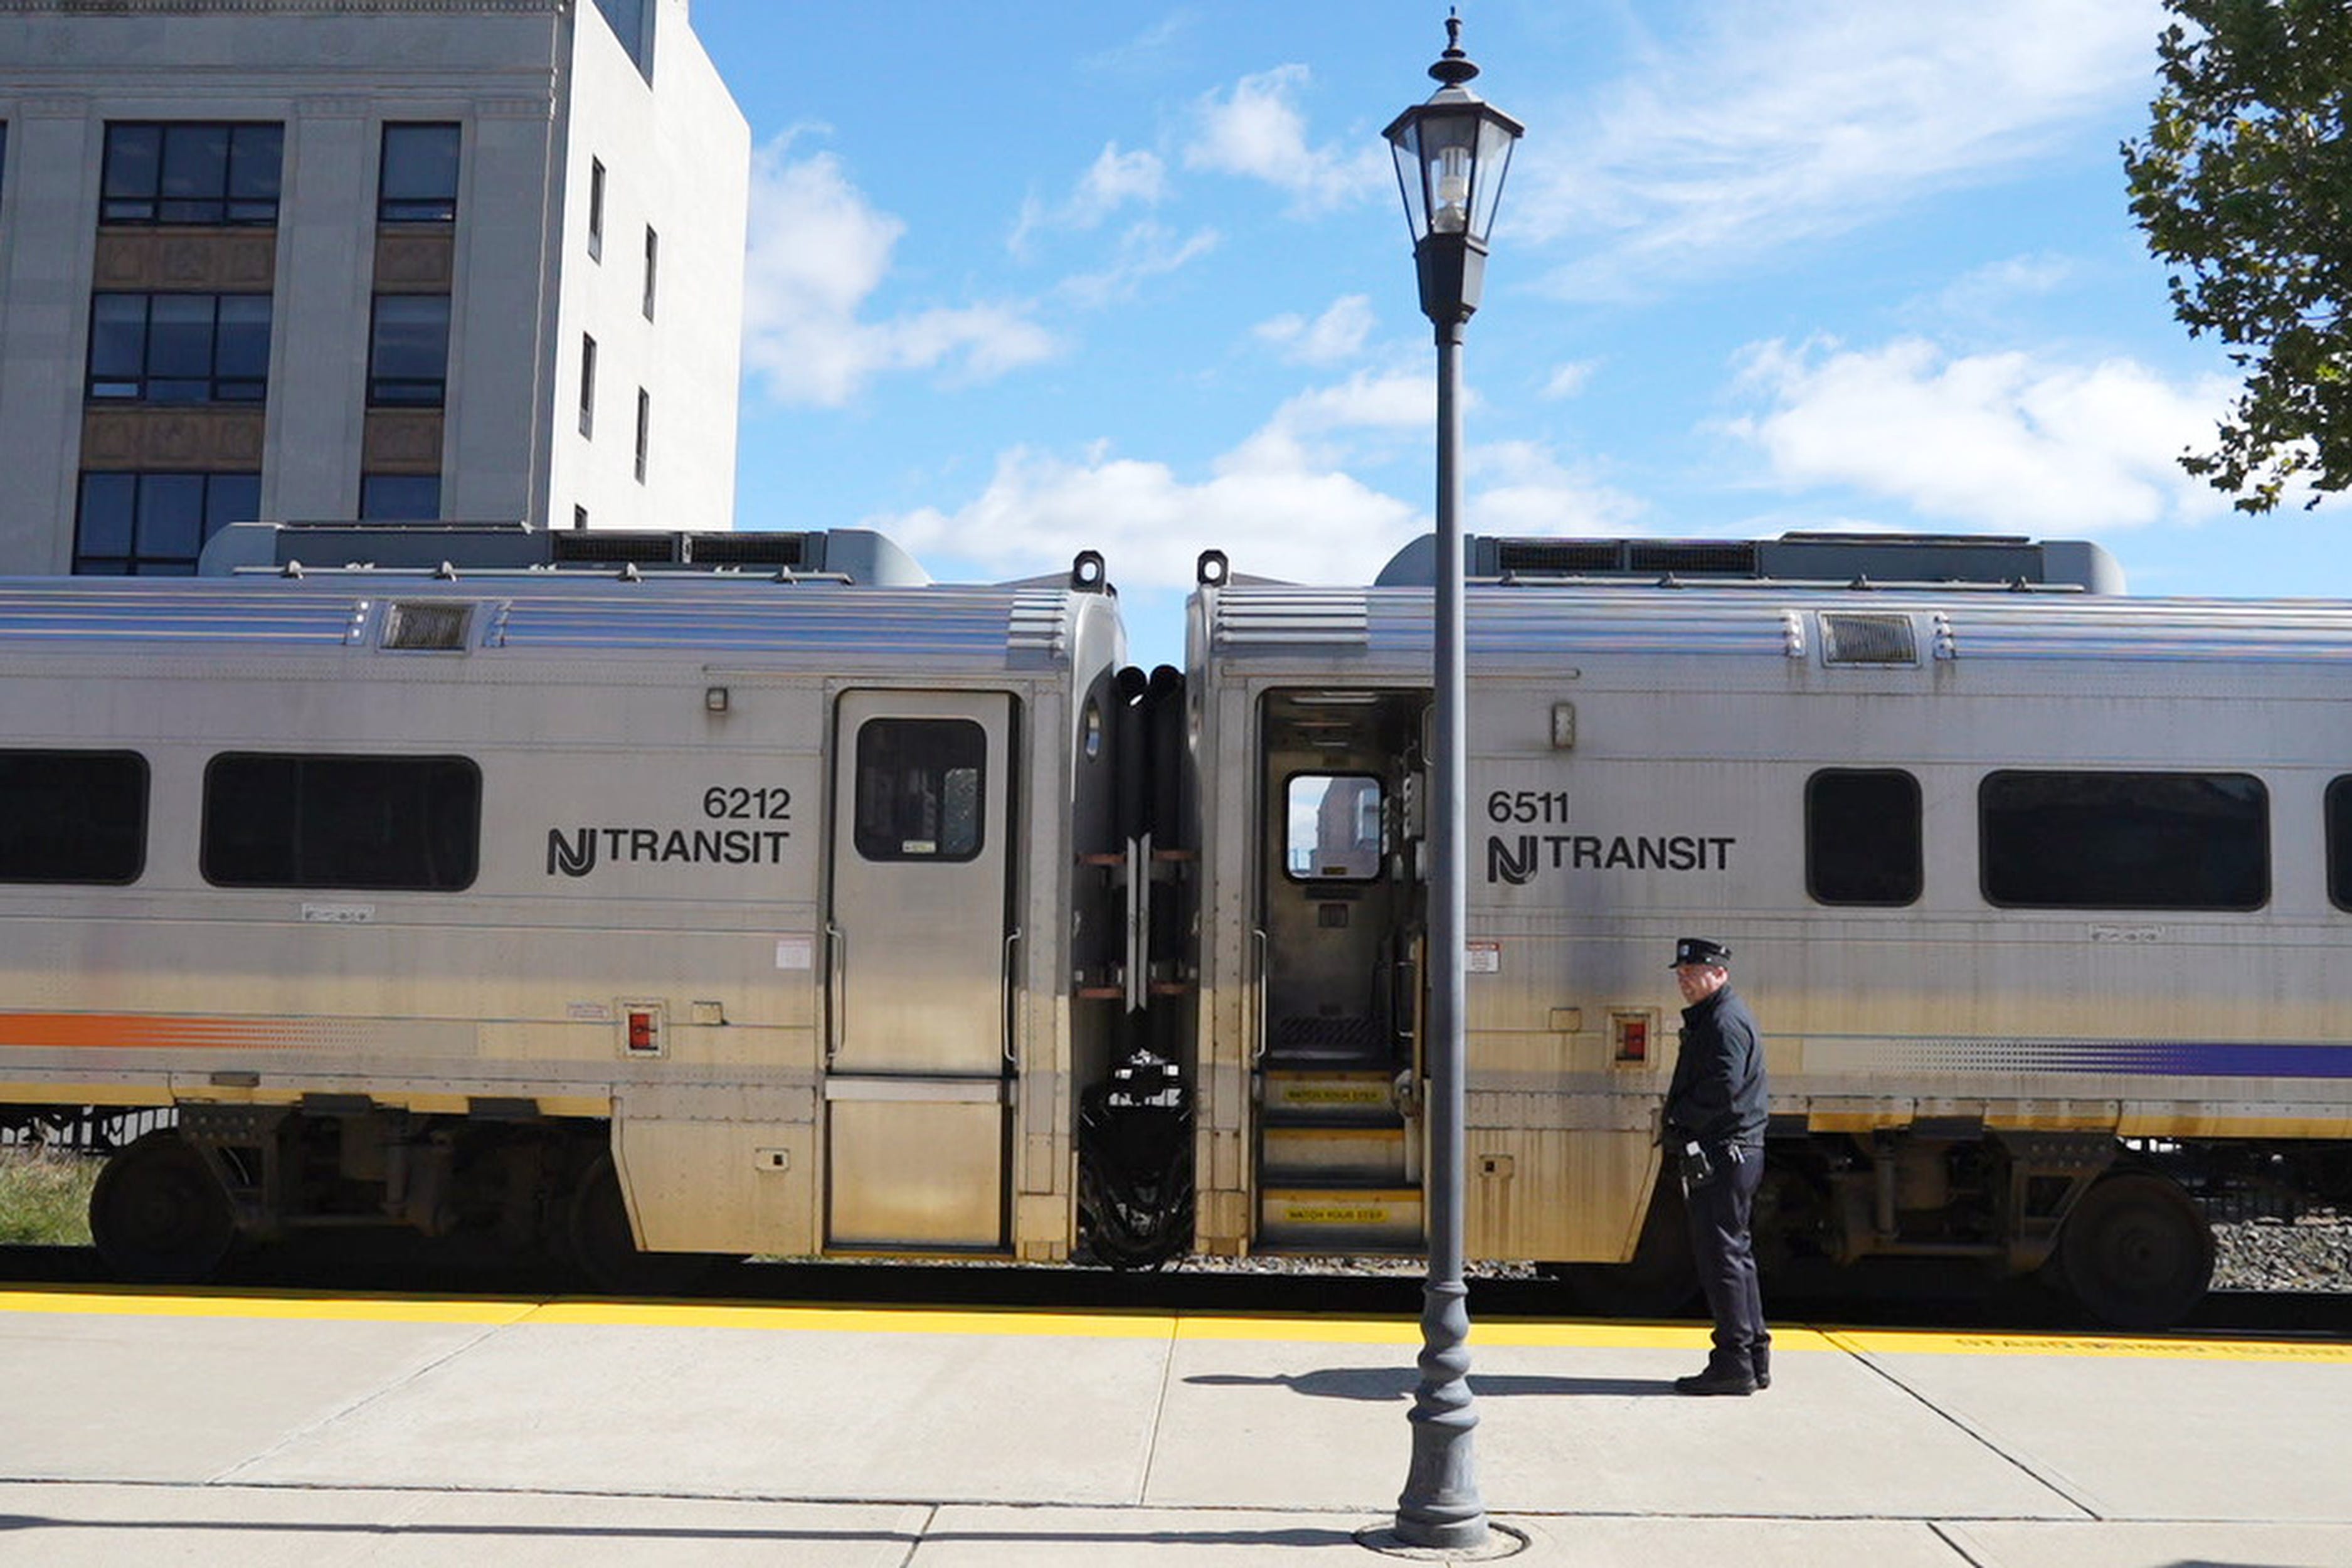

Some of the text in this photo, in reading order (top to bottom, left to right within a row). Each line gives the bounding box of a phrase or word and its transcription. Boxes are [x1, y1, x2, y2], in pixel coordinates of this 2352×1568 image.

[703, 787, 791, 820] 6212
[1487, 790, 1569, 824] 6511
[546, 827, 790, 877] NJ TRANSIT
[1487, 834, 1737, 886] NJ TRANSIT
[1290, 1210, 1384, 1220] WATCH YOUR STEP
